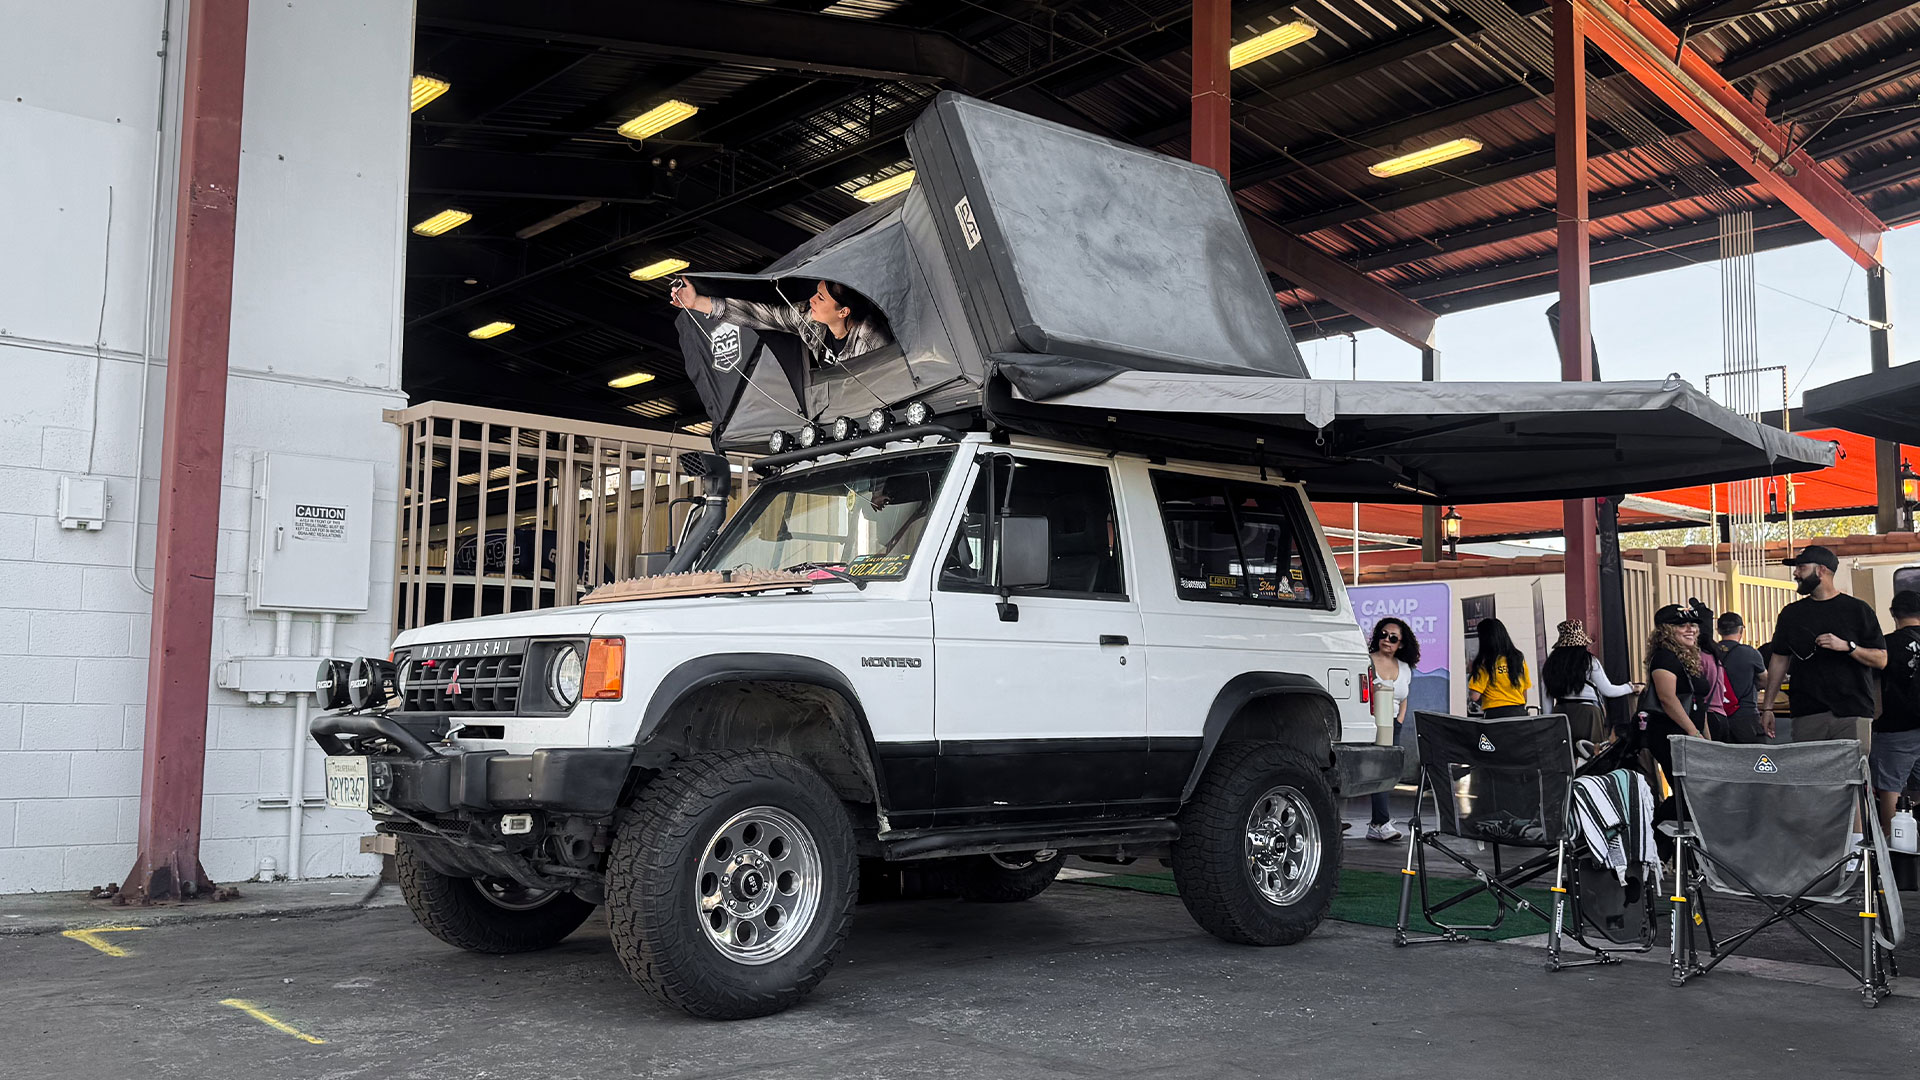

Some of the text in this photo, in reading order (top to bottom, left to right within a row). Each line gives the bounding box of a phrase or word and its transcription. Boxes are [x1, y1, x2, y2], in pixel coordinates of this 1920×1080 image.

[296, 506, 344, 519] CAUTION
[1361, 599, 1418, 616] CAMP
[422, 641, 510, 658] MITSUBISHI
[861, 656, 922, 668] MONTERO
[329, 776, 365, 803] 2PYR367
